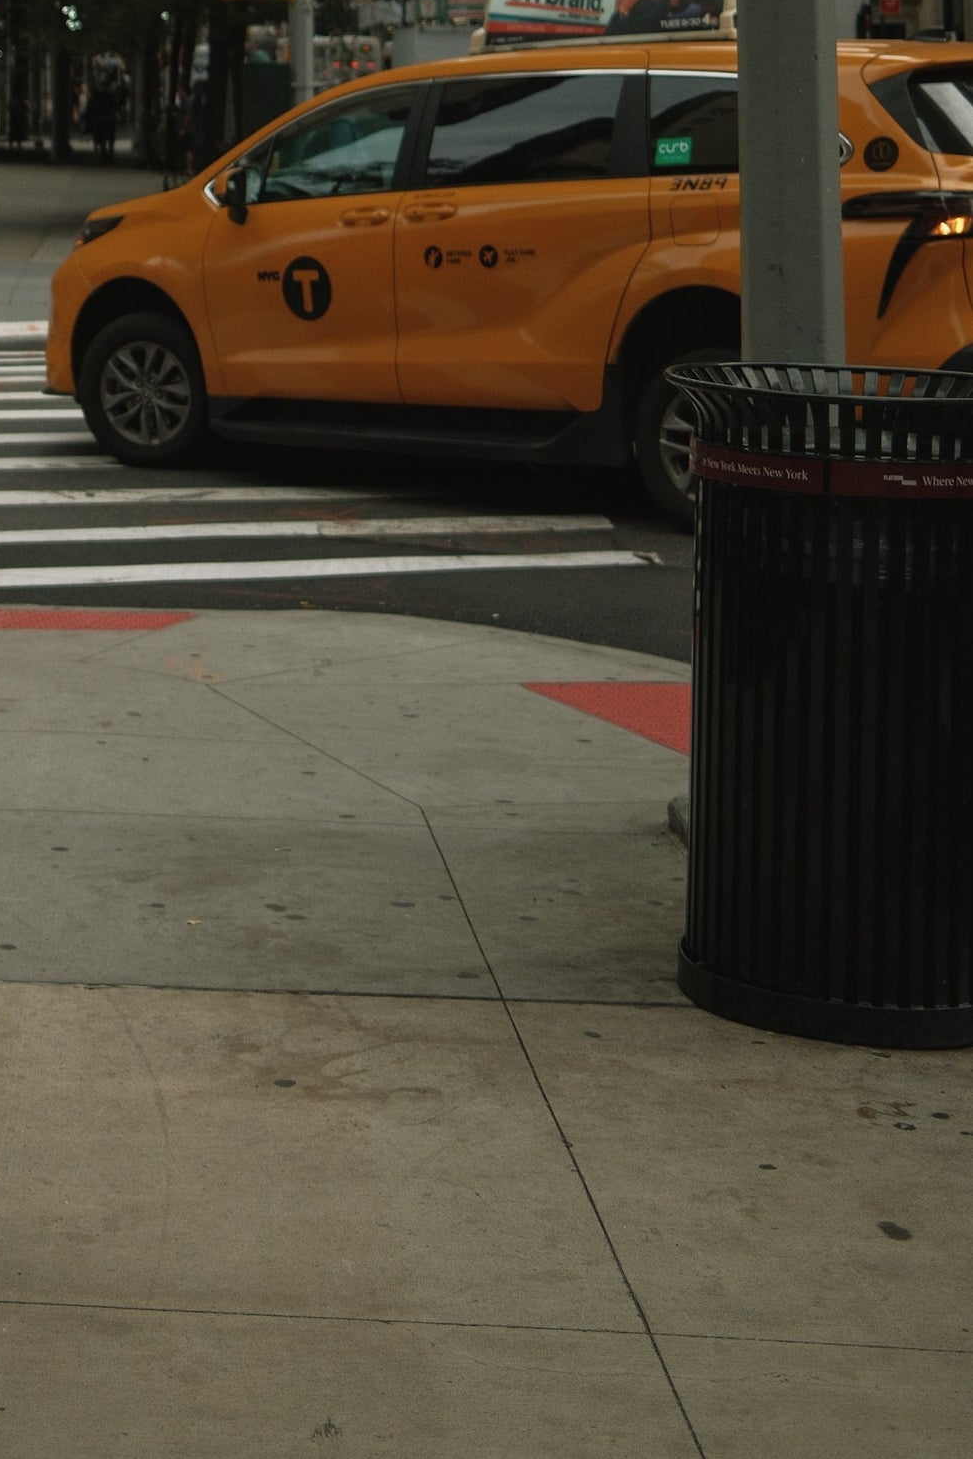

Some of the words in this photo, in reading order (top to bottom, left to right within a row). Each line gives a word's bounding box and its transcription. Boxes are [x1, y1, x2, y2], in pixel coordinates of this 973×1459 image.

[658, 141, 689, 154] curb
[257, 270, 280, 282] NYC
[291, 268, 320, 313] T
[707, 457, 719, 469] New
[720, 459, 737, 472] York
[737, 462, 761, 476] Meets
[762, 466, 784, 478] New
[785, 468, 809, 481] York
[922, 475, 955, 486] Where
